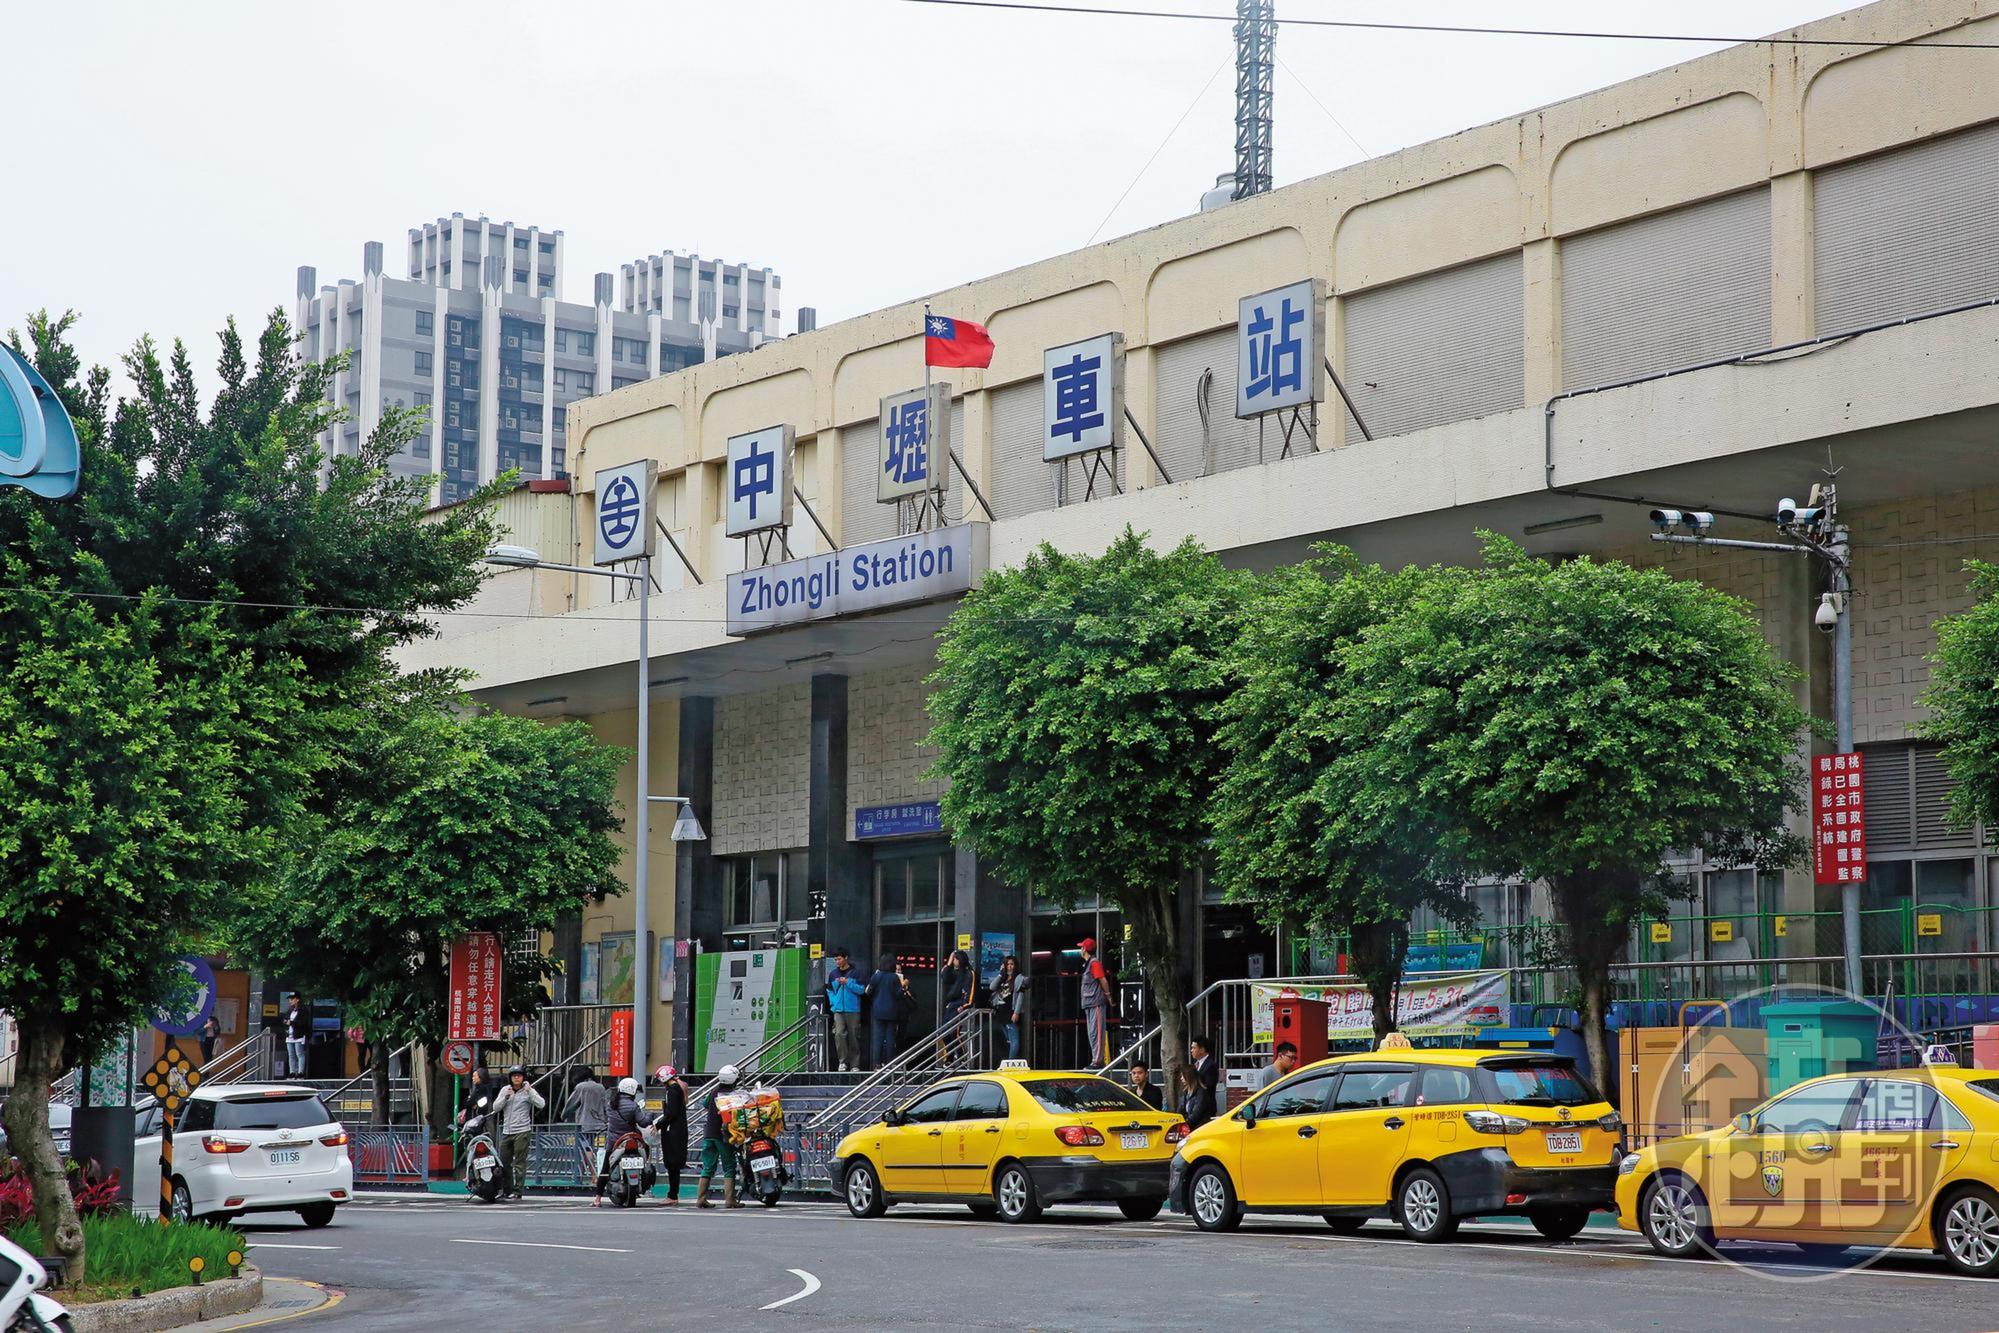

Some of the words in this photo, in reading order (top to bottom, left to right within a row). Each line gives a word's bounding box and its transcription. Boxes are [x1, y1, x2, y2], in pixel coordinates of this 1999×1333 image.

[740, 568, 840, 618] Zhongli
[851, 544, 954, 591] Station
[466, 936, 480, 1038] 請勿任意穿越道路
[483, 935, 496, 1038] 行人請走行人穿越道
[1548, 1134, 1581, 1150] TDB-2851
[1759, 1150, 1786, 1165] 1560
